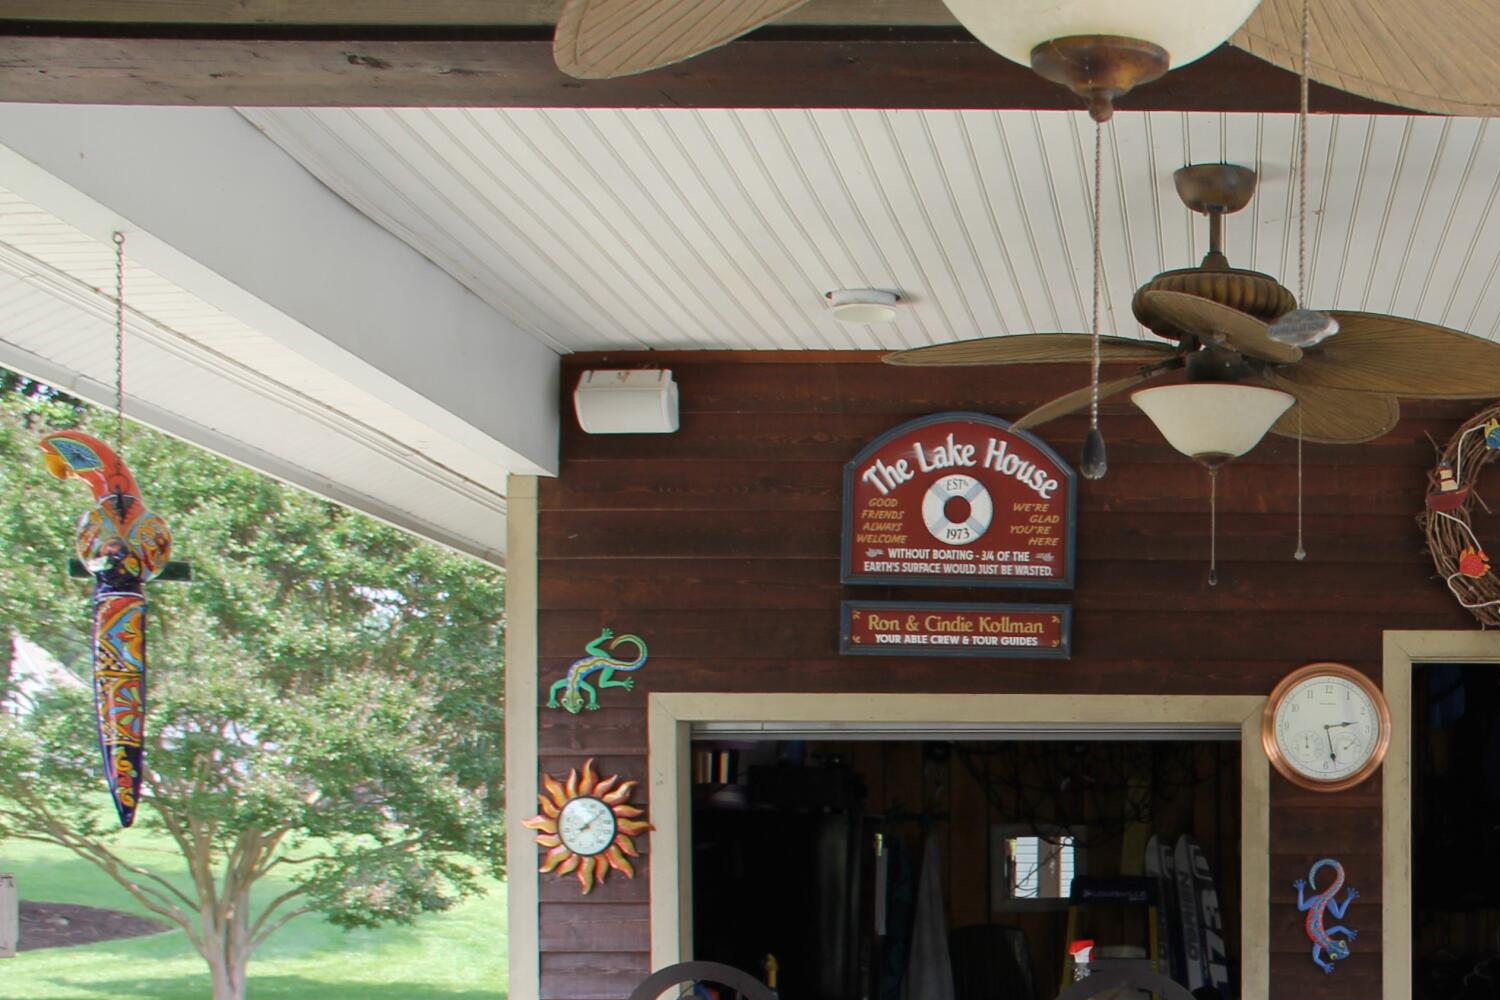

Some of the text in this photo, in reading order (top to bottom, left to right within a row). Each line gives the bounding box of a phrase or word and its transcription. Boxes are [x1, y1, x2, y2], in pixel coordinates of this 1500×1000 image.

[863, 433, 1059, 499] The Lake House
[869, 498, 898, 507] GOOD
[862, 510, 904, 520] FRIENDS
[1029, 515, 1060, 523] GLAD
[863, 522, 903, 532] ALWAYS
[857, 534, 908, 544] WELCOME
[946, 528, 970, 540] 1973
[1028, 537, 1060, 546] HERE
[888, 548, 930, 559] WITHOUT
[932, 549, 974, 560] BOATING
[981, 550, 994, 561] 3/4
[997, 551, 1010, 561] OF
[1012, 551, 1030, 561] THE
[864, 561, 900, 572] EARTH'S
[902, 562, 941, 573] SURFACE
[943, 563, 976, 574] WOULD
[978, 564, 998, 575] JUST
[1001, 565, 1013, 575] BE
[868, 614, 1045, 633] Ron & Cindie Kollman
[875, 634, 1038, 646] YOUR ABLE CREW & TOUR GUIDES
[1307, 689, 1313, 699] 11
[1325, 685, 1333, 694] 12
[1291, 704, 1299, 712] 10
